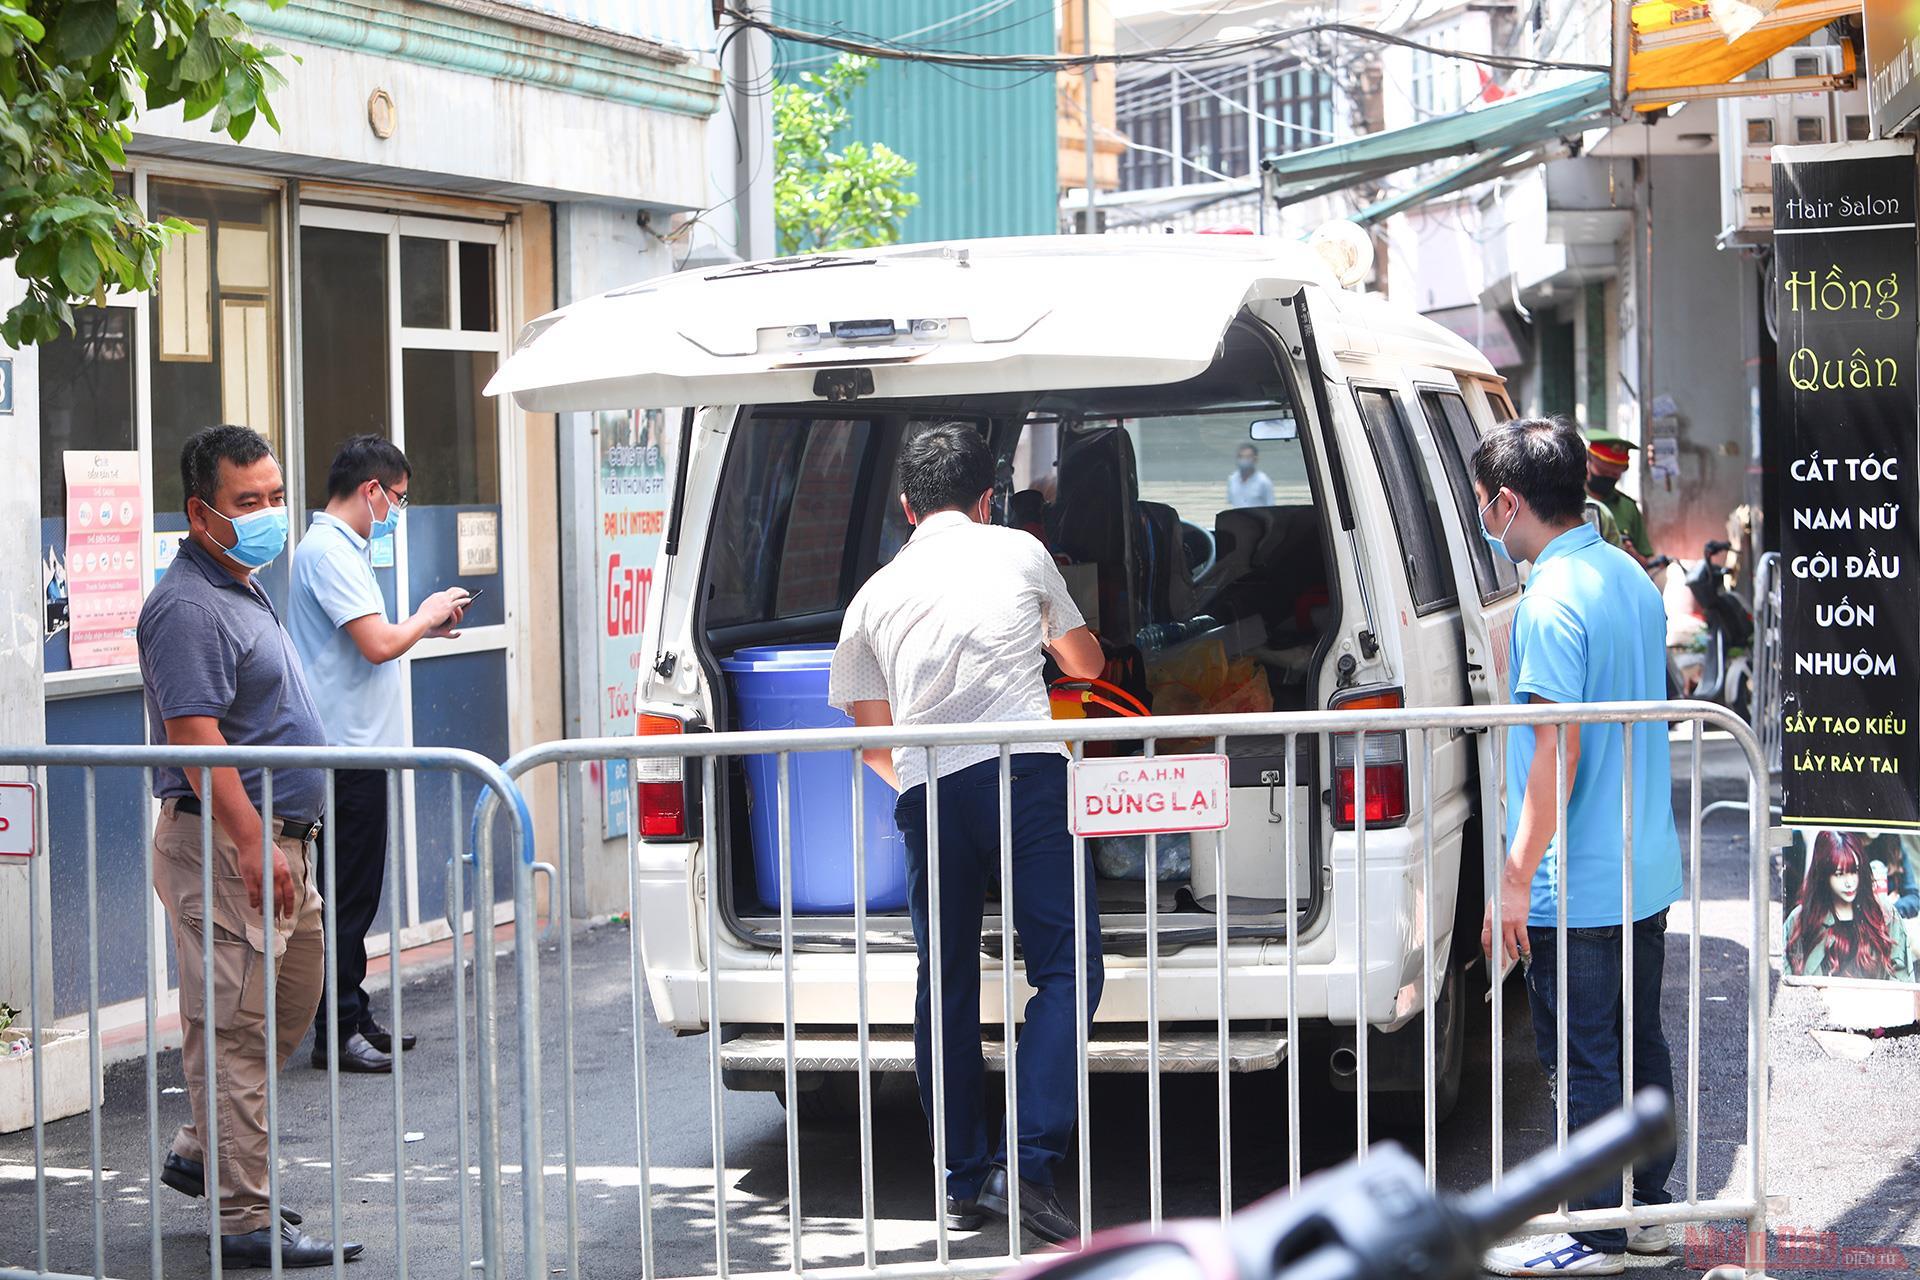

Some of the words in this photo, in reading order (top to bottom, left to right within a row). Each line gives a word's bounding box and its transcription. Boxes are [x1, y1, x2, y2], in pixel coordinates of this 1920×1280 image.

[1786, 198, 1833, 219] Hair
[1838, 195, 1900, 217] Salon
[1784, 263, 1901, 321] Hồng
[1789, 347, 1898, 391] Quân
[1790, 450, 1838, 482] CẮT
[1845, 453, 1898, 482] TÓC
[630, 510, 664, 535] INTERNET
[1794, 508, 1851, 531] NAM
[1859, 503, 1900, 531] NỮ
[1791, 551, 1838, 582] GỘI
[1845, 547, 1900, 579] ĐẦU
[1815, 595, 1875, 628] UỐN
[1794, 648, 1897, 679] NHUỘM
[1822, 716, 1861, 737] TẠO
[1865, 710, 1907, 735] KIỂU
[1118, 767, 1185, 783] C.A.H.N
[1831, 752, 1866, 773] RÁY
[1870, 757, 1899, 774] TAI
[1172, 789, 1218, 815] LẠI
